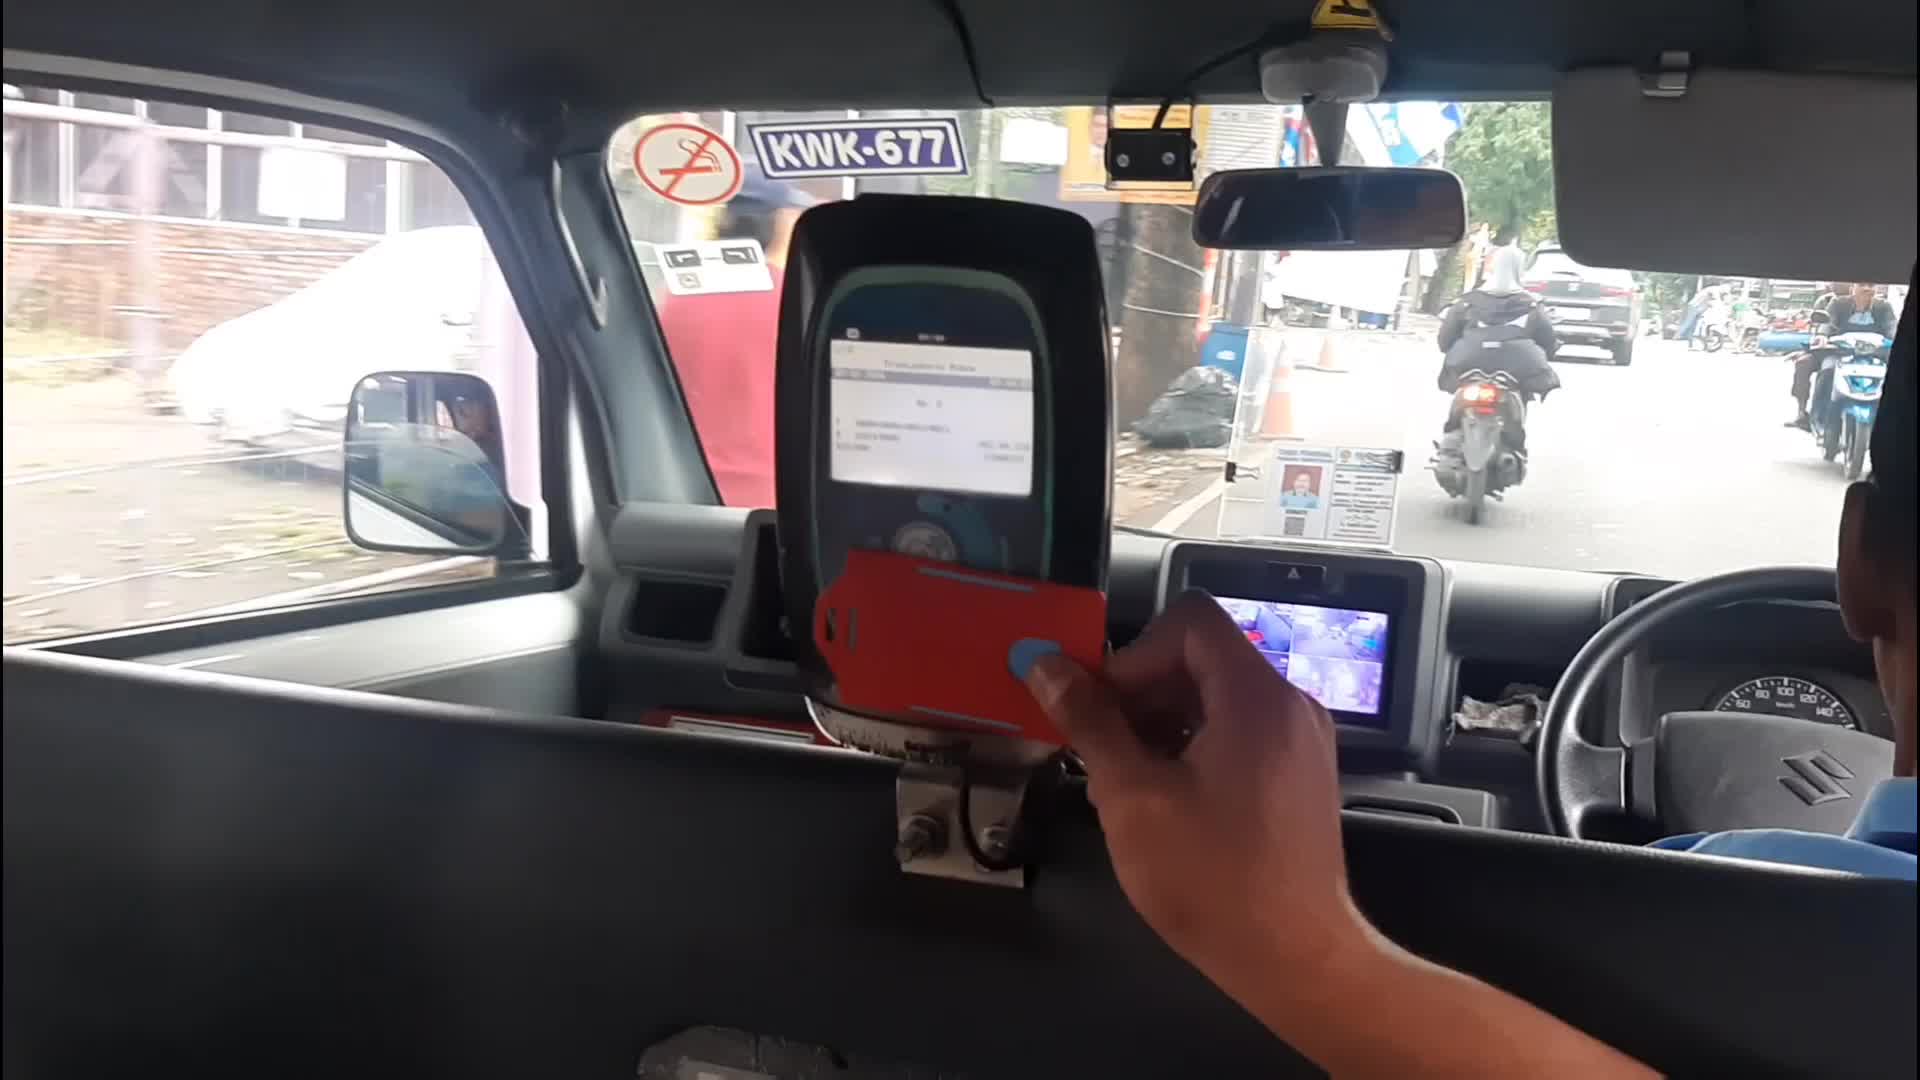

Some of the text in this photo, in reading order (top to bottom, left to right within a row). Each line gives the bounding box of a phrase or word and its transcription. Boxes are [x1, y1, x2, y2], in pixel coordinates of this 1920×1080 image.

[767, 129, 945, 168] KWK-677
[1754, 688, 1770, 699] 80
[1776, 686, 1795, 697] 100
[1735, 699, 1751, 709] 60
[1799, 693, 1817, 704] 120
[1815, 706, 1834, 718] 140
